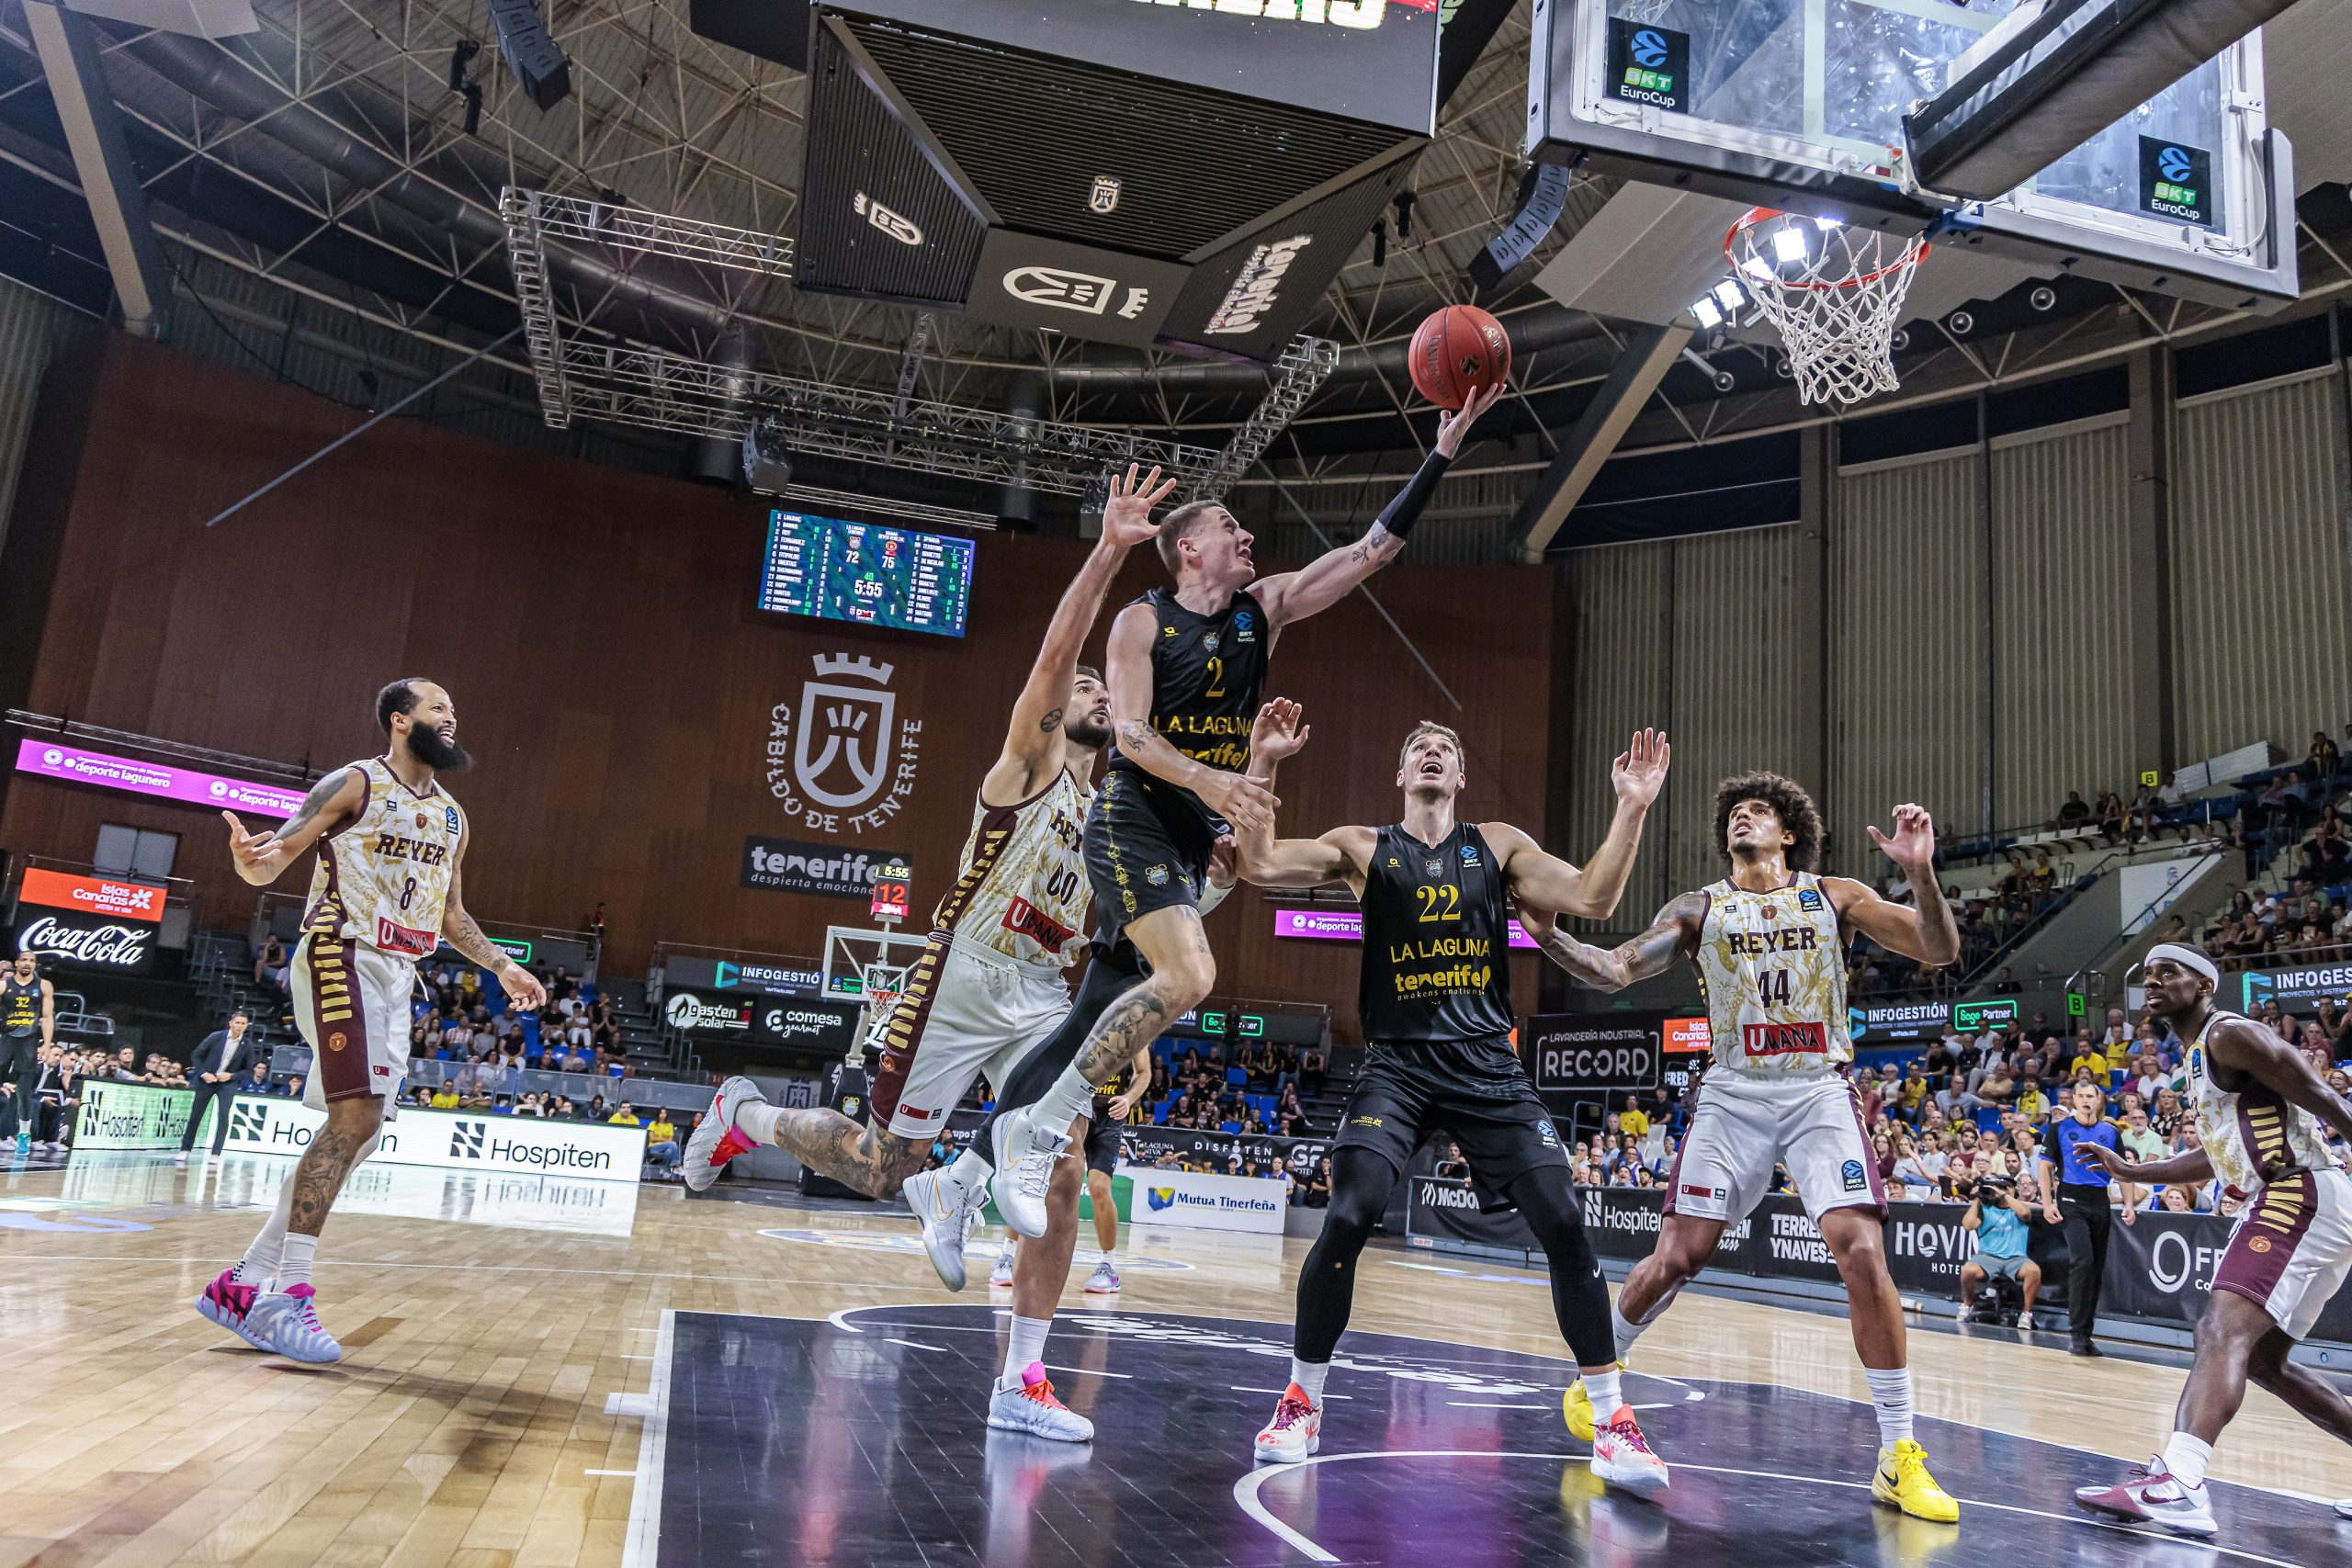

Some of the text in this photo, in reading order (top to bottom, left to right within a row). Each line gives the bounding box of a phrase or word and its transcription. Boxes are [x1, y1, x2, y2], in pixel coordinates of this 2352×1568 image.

[1625, 69, 1672, 90] BKT
[1620, 85, 1676, 108] EuroCup
[2154, 183, 2196, 205] BKT
[2151, 198, 2200, 220] EuroCup
[845, 549, 860, 564] 72
[882, 555, 895, 569] 75
[854, 579, 883, 599] 5:55
[835, 595, 842, 607] 1
[889, 604, 895, 615] 1
[1205, 656, 1226, 698] 2
[75, 761, 119, 779] deporte
[120, 769, 171, 788] lagunero
[765, 702, 922, 834] CABILDO DE TENERIFE
[239, 792, 279, 808] deporte
[374, 833, 447, 867] REYER
[884, 865, 910, 877] 5:55
[101, 883, 130, 897] Islas
[400, 876, 417, 910] 8
[751, 872, 875, 895] despierta emocione
[73, 888, 130, 906] Canarias
[879, 883, 907, 905] 12
[1416, 884, 1462, 923] 22
[1316, 921, 1350, 933] deporte
[18, 916, 153, 965] Coca-Cola
[1727, 926, 1817, 955] REYER
[1390, 938, 1491, 964] LA LAGUNA
[741, 966, 820, 985] INFOGESTIÓ
[1395, 964, 1481, 993] tenerife
[1396, 989, 1439, 1002] awakens
[1758, 968, 1791, 1009] 44
[2278, 988, 2316, 998] PROYECTOS
[15, 996, 30, 1009] 32
[690, 1002, 737, 1019] gasten
[1868, 1000, 1949, 1022] INFOGESTIÓN
[2072, 997, 2082, 1011] B
[697, 1016, 727, 1030] solar
[786, 1010, 842, 1027] comesa
[1982, 1009, 2012, 1021] Partner
[781, 1022, 825, 1038] gourmet
[1549, 1028, 1646, 1043] LAVANDERÍA INDUSTRIAL
[1672, 1031, 1708, 1042] Canarias
[1689, 1021, 1708, 1032] Islas
[1749, 1026, 1821, 1053] UMANA
[1544, 1047, 1650, 1077] RECORD
[490, 1138, 612, 1171] Hospiten
[1144, 1141, 1175, 1151] LAGUNA
[1291, 1144, 1325, 1168] GF
[1177, 1192, 1277, 1212] Mutua Tinerfeña
[1770, 1236, 1828, 1264] YNAVES
[1931, 1262, 1964, 1276] HOTE
